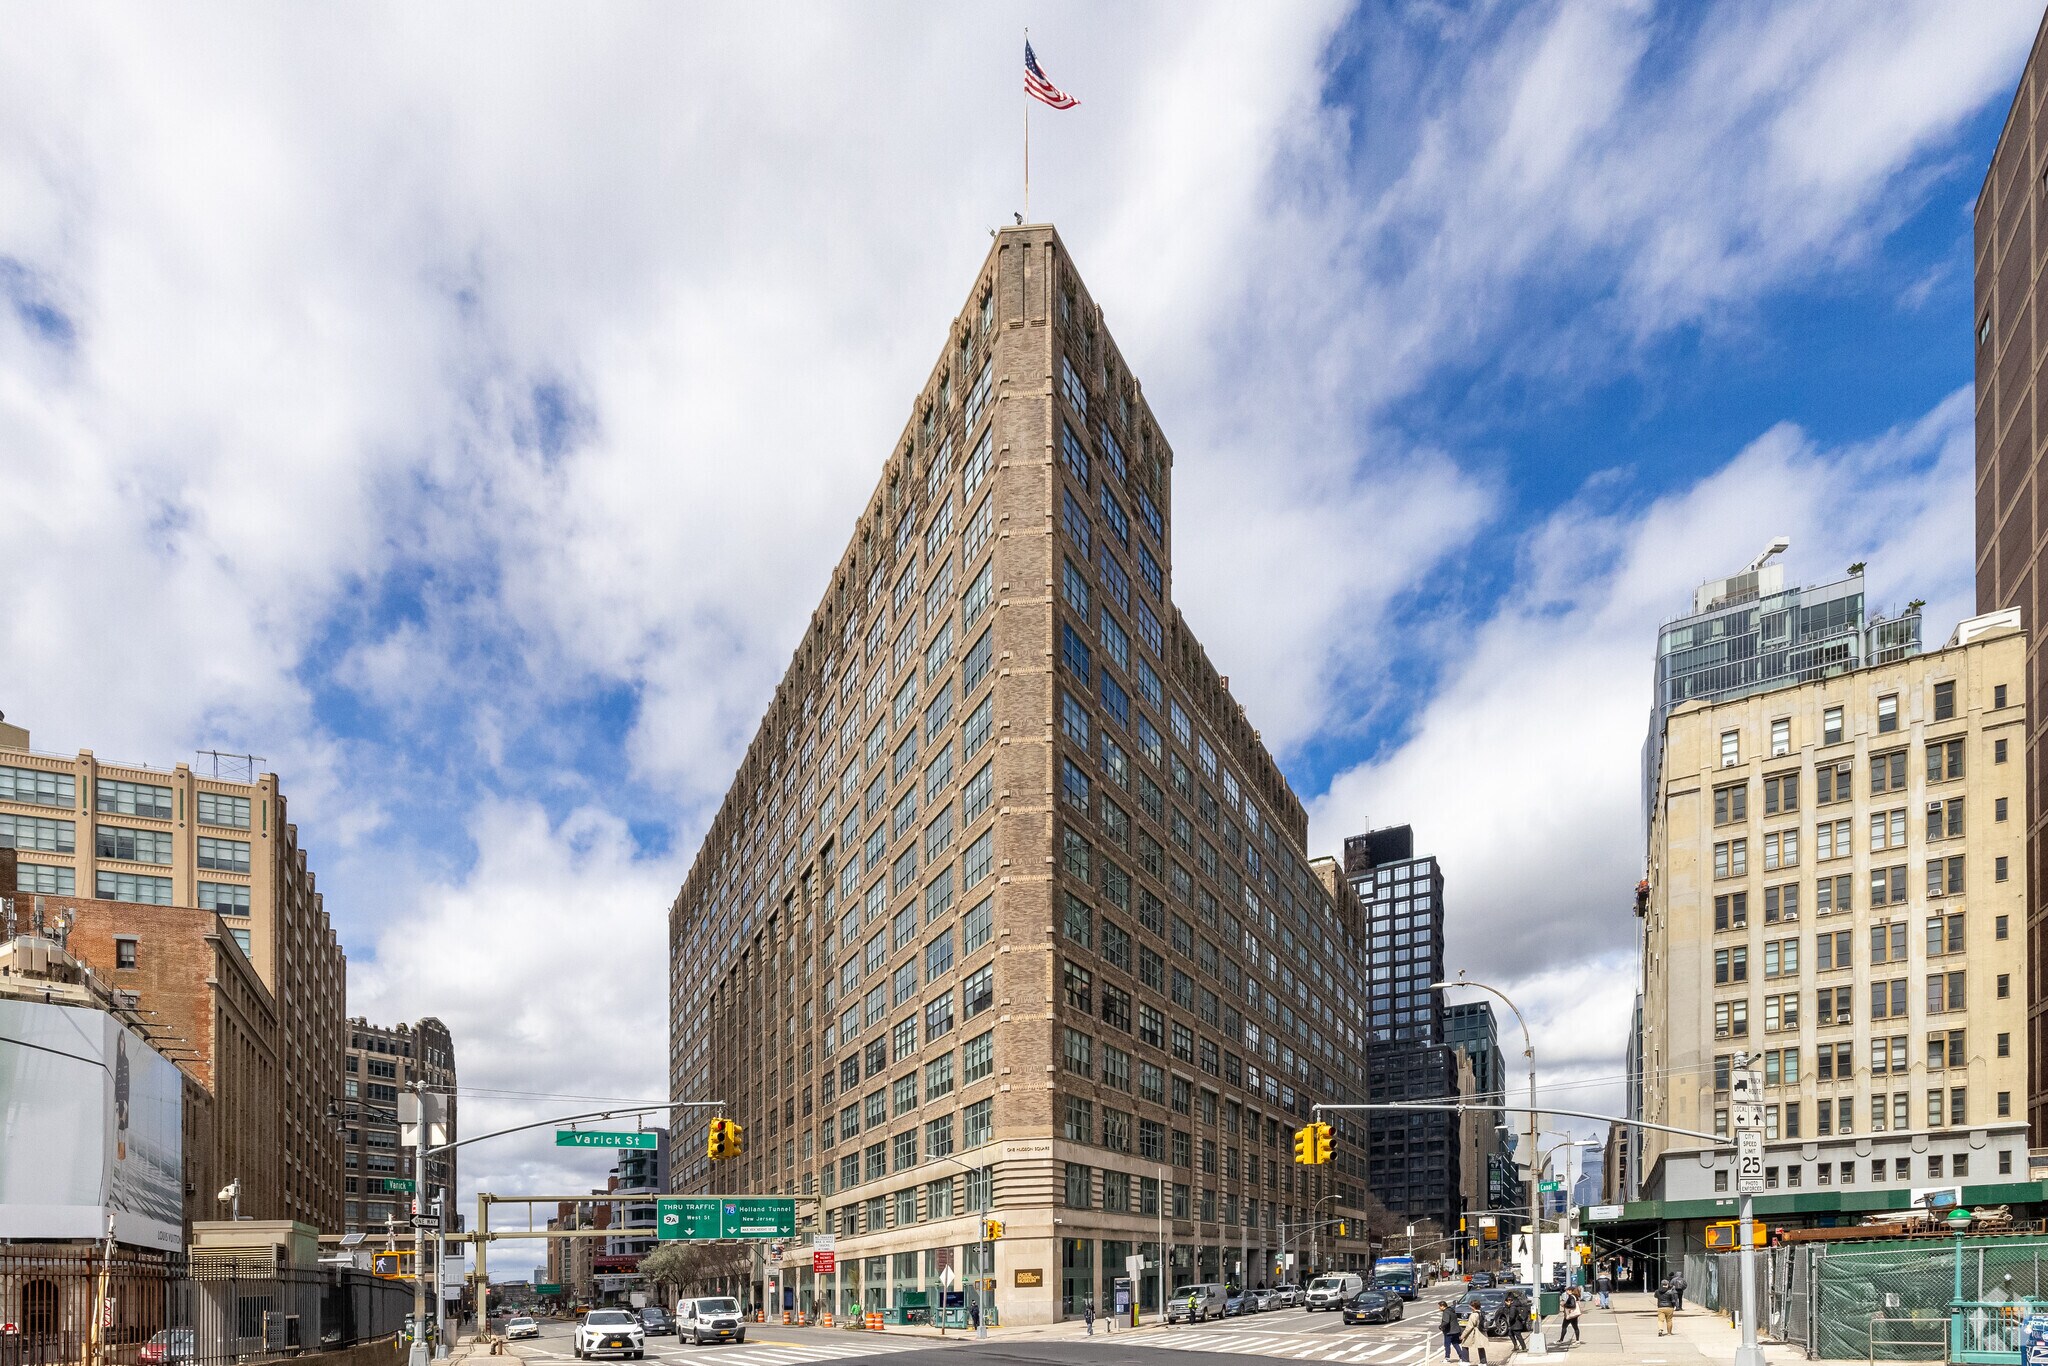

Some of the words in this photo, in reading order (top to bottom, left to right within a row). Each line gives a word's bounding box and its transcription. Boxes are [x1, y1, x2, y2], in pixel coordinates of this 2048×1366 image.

[1748, 1077, 1761, 1085] TRUCK
[574, 1134, 621, 1145] Varick
[626, 1136, 640, 1145] St
[1742, 1156, 1761, 1174] 25
[389, 1180, 407, 1190] Varick
[1540, 1183, 1553, 1191] Canal
[725, 1206, 735, 1214] 78
